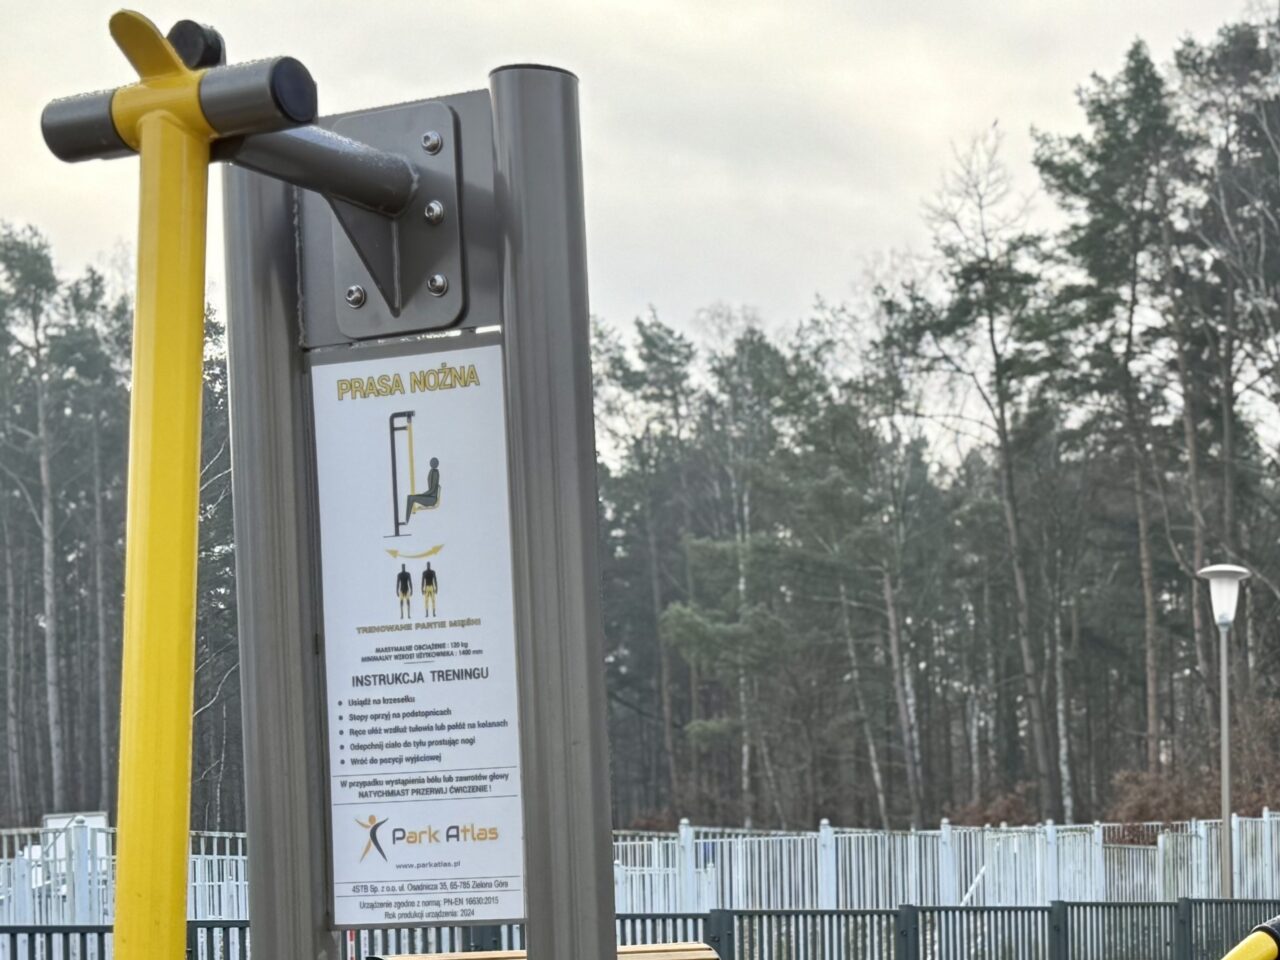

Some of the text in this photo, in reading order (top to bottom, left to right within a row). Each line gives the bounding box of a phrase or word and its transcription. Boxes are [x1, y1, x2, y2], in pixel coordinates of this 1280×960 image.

[337, 362, 480, 400] PRASA NOŻNA
[415, 622, 446, 631] PARTIE
[352, 667, 489, 687] INSTRUKCJA TRENINGU
[382, 696, 415, 704] krzesełku
[349, 713, 368, 722] Stopy
[370, 712, 391, 721] oprzyj
[402, 708, 452, 720] podstopnicach
[349, 729, 366, 737] Ręce
[478, 720, 508, 728] kolanach
[350, 742, 384, 752] Odepchnij
[428, 738, 459, 748] prostując
[351, 757, 368, 765] Wróć
[380, 755, 403, 765] pozycji
[349, 778, 383, 789] przypadku
[385, 776, 425, 787] wystąpienia
[427, 775, 442, 784] bólu
[455, 773, 488, 782] zawrotów
[489, 772, 509, 782] głowy
[358, 788, 409, 798] NATYCHMIAST
[411, 787, 448, 796] PRZERWIJ
[449, 785, 487, 794] ĆWICZENIE
[392, 823, 499, 845] Park Atlas
[396, 861, 460, 869] www.parkatlas.pl
[450, 881, 470, 889] 65-785
[443, 898, 463, 906] PN-EN
[398, 910, 424, 920] produkcji
